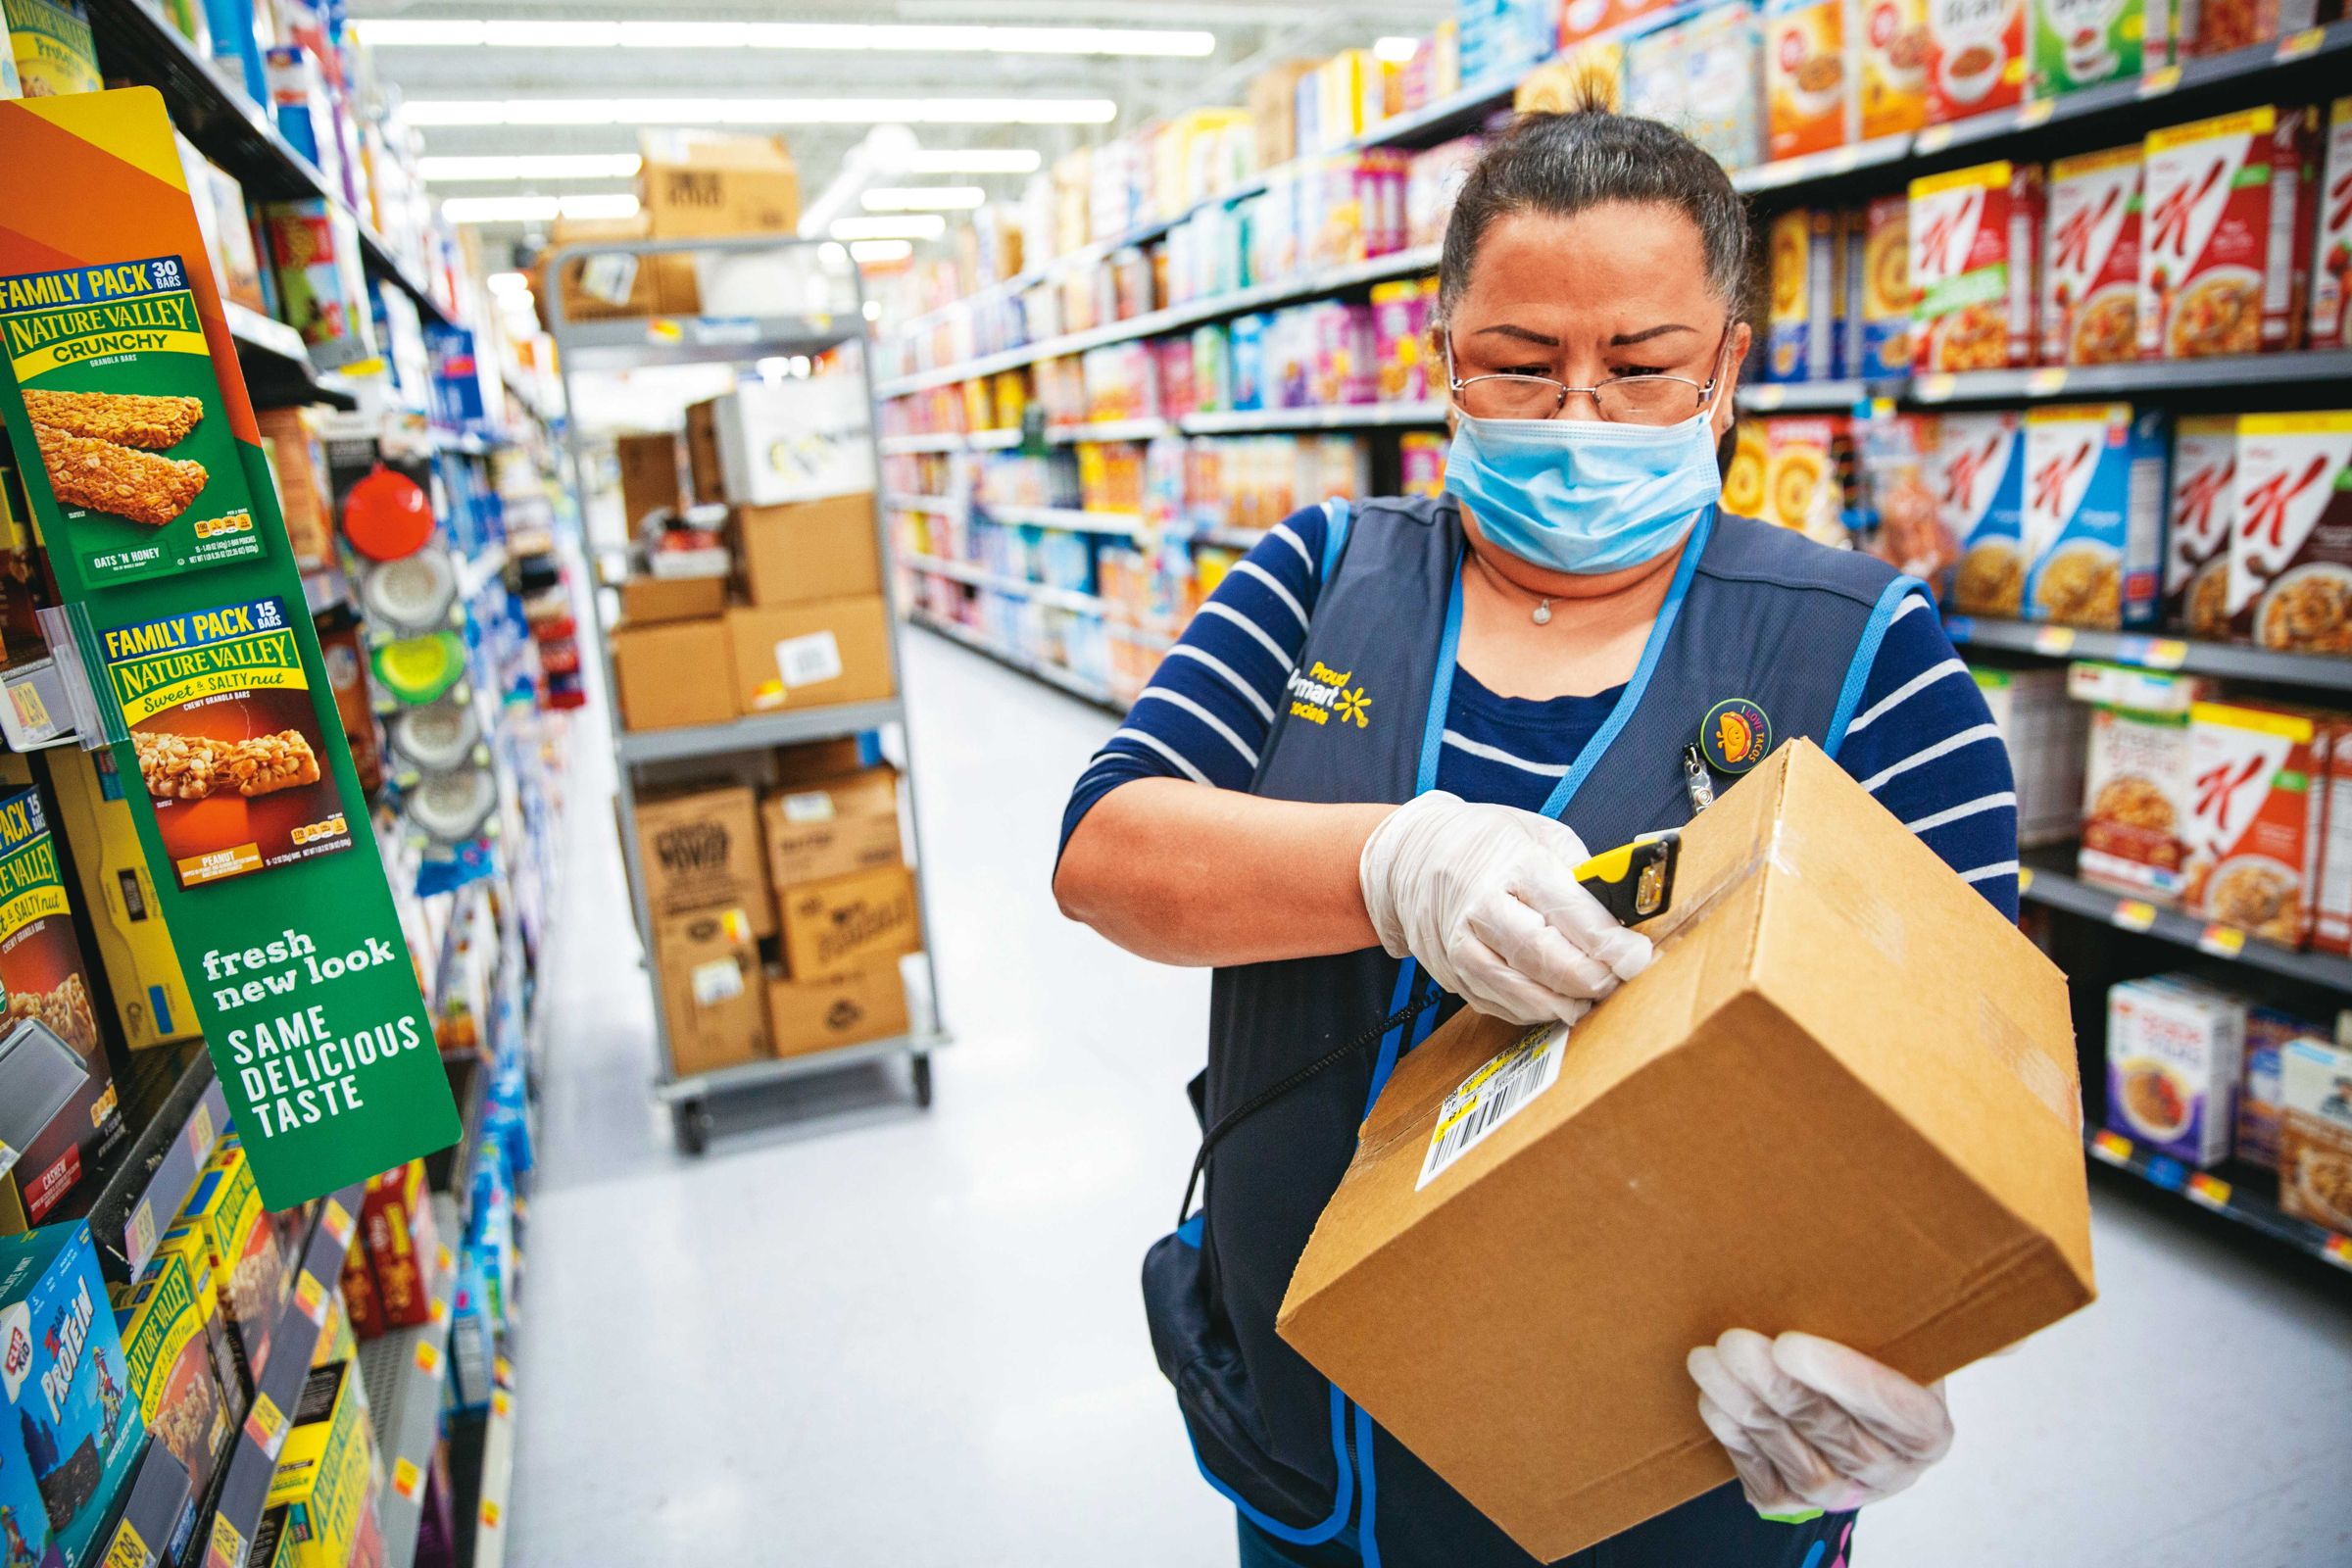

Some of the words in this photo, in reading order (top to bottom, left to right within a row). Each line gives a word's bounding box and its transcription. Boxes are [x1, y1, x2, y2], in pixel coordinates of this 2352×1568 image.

[2152, 157, 2226, 257] K
[87, 264, 152, 297] PACK
[152, 261, 177, 278] 30
[156, 275, 181, 289] BARS
[8, 310, 105, 355] NATURE
[103, 297, 188, 329] VALLEY
[53, 334, 168, 363] CRUNCHY
[90, 357, 119, 368] GRANOLA
[121, 354, 136, 364] BARS
[2034, 440, 2091, 517] K
[2242, 453, 2329, 548] K
[94, 555, 117, 568] OATS
[131, 547, 160, 562] HONEY
[256, 601, 276, 617] 15
[257, 614, 281, 629] BARS
[106, 618, 186, 659] FAMILY
[192, 606, 255, 641] PACK
[120, 650, 210, 700] NATURE
[208, 635, 288, 667] VALLEY
[1309, 661, 1352, 688] Proud
[144, 685, 195, 713] Sweet
[197, 681, 205, 691] &
[208, 672, 247, 691] SALTY
[251, 672, 284, 685] nut
[183, 699, 205, 711] CHEWY
[205, 694, 234, 706] GRANOLA
[234, 691, 251, 700] BARS
[1741, 705, 1746, 713] I
[1744, 709, 1764, 732] LOVE
[1748, 732, 1765, 762] TACOS
[27, 793, 40, 815] 15
[2195, 754, 2267, 831] K
[0, 800, 32, 850] ACK
[31, 812, 46, 832] BARS
[8, 840, 58, 887] VALLEY
[202, 851, 235, 867] PEANUT
[14, 893, 40, 923] SALTY
[41, 892, 60, 910] nut
[2, 938, 18, 955] CHEWY
[203, 929, 317, 981] fresh
[213, 969, 297, 1011] new
[304, 938, 395, 984] look
[227, 1004, 331, 1065] SAME
[240, 1015, 419, 1102] DELICIOUS
[252, 1075, 364, 1138] TASTE
[127, 1319, 163, 1400] NATURE
[154, 1262, 191, 1329] VALLEY
[6, 1326, 24, 1375] CLIF
[18, 1341, 30, 1371] KID
